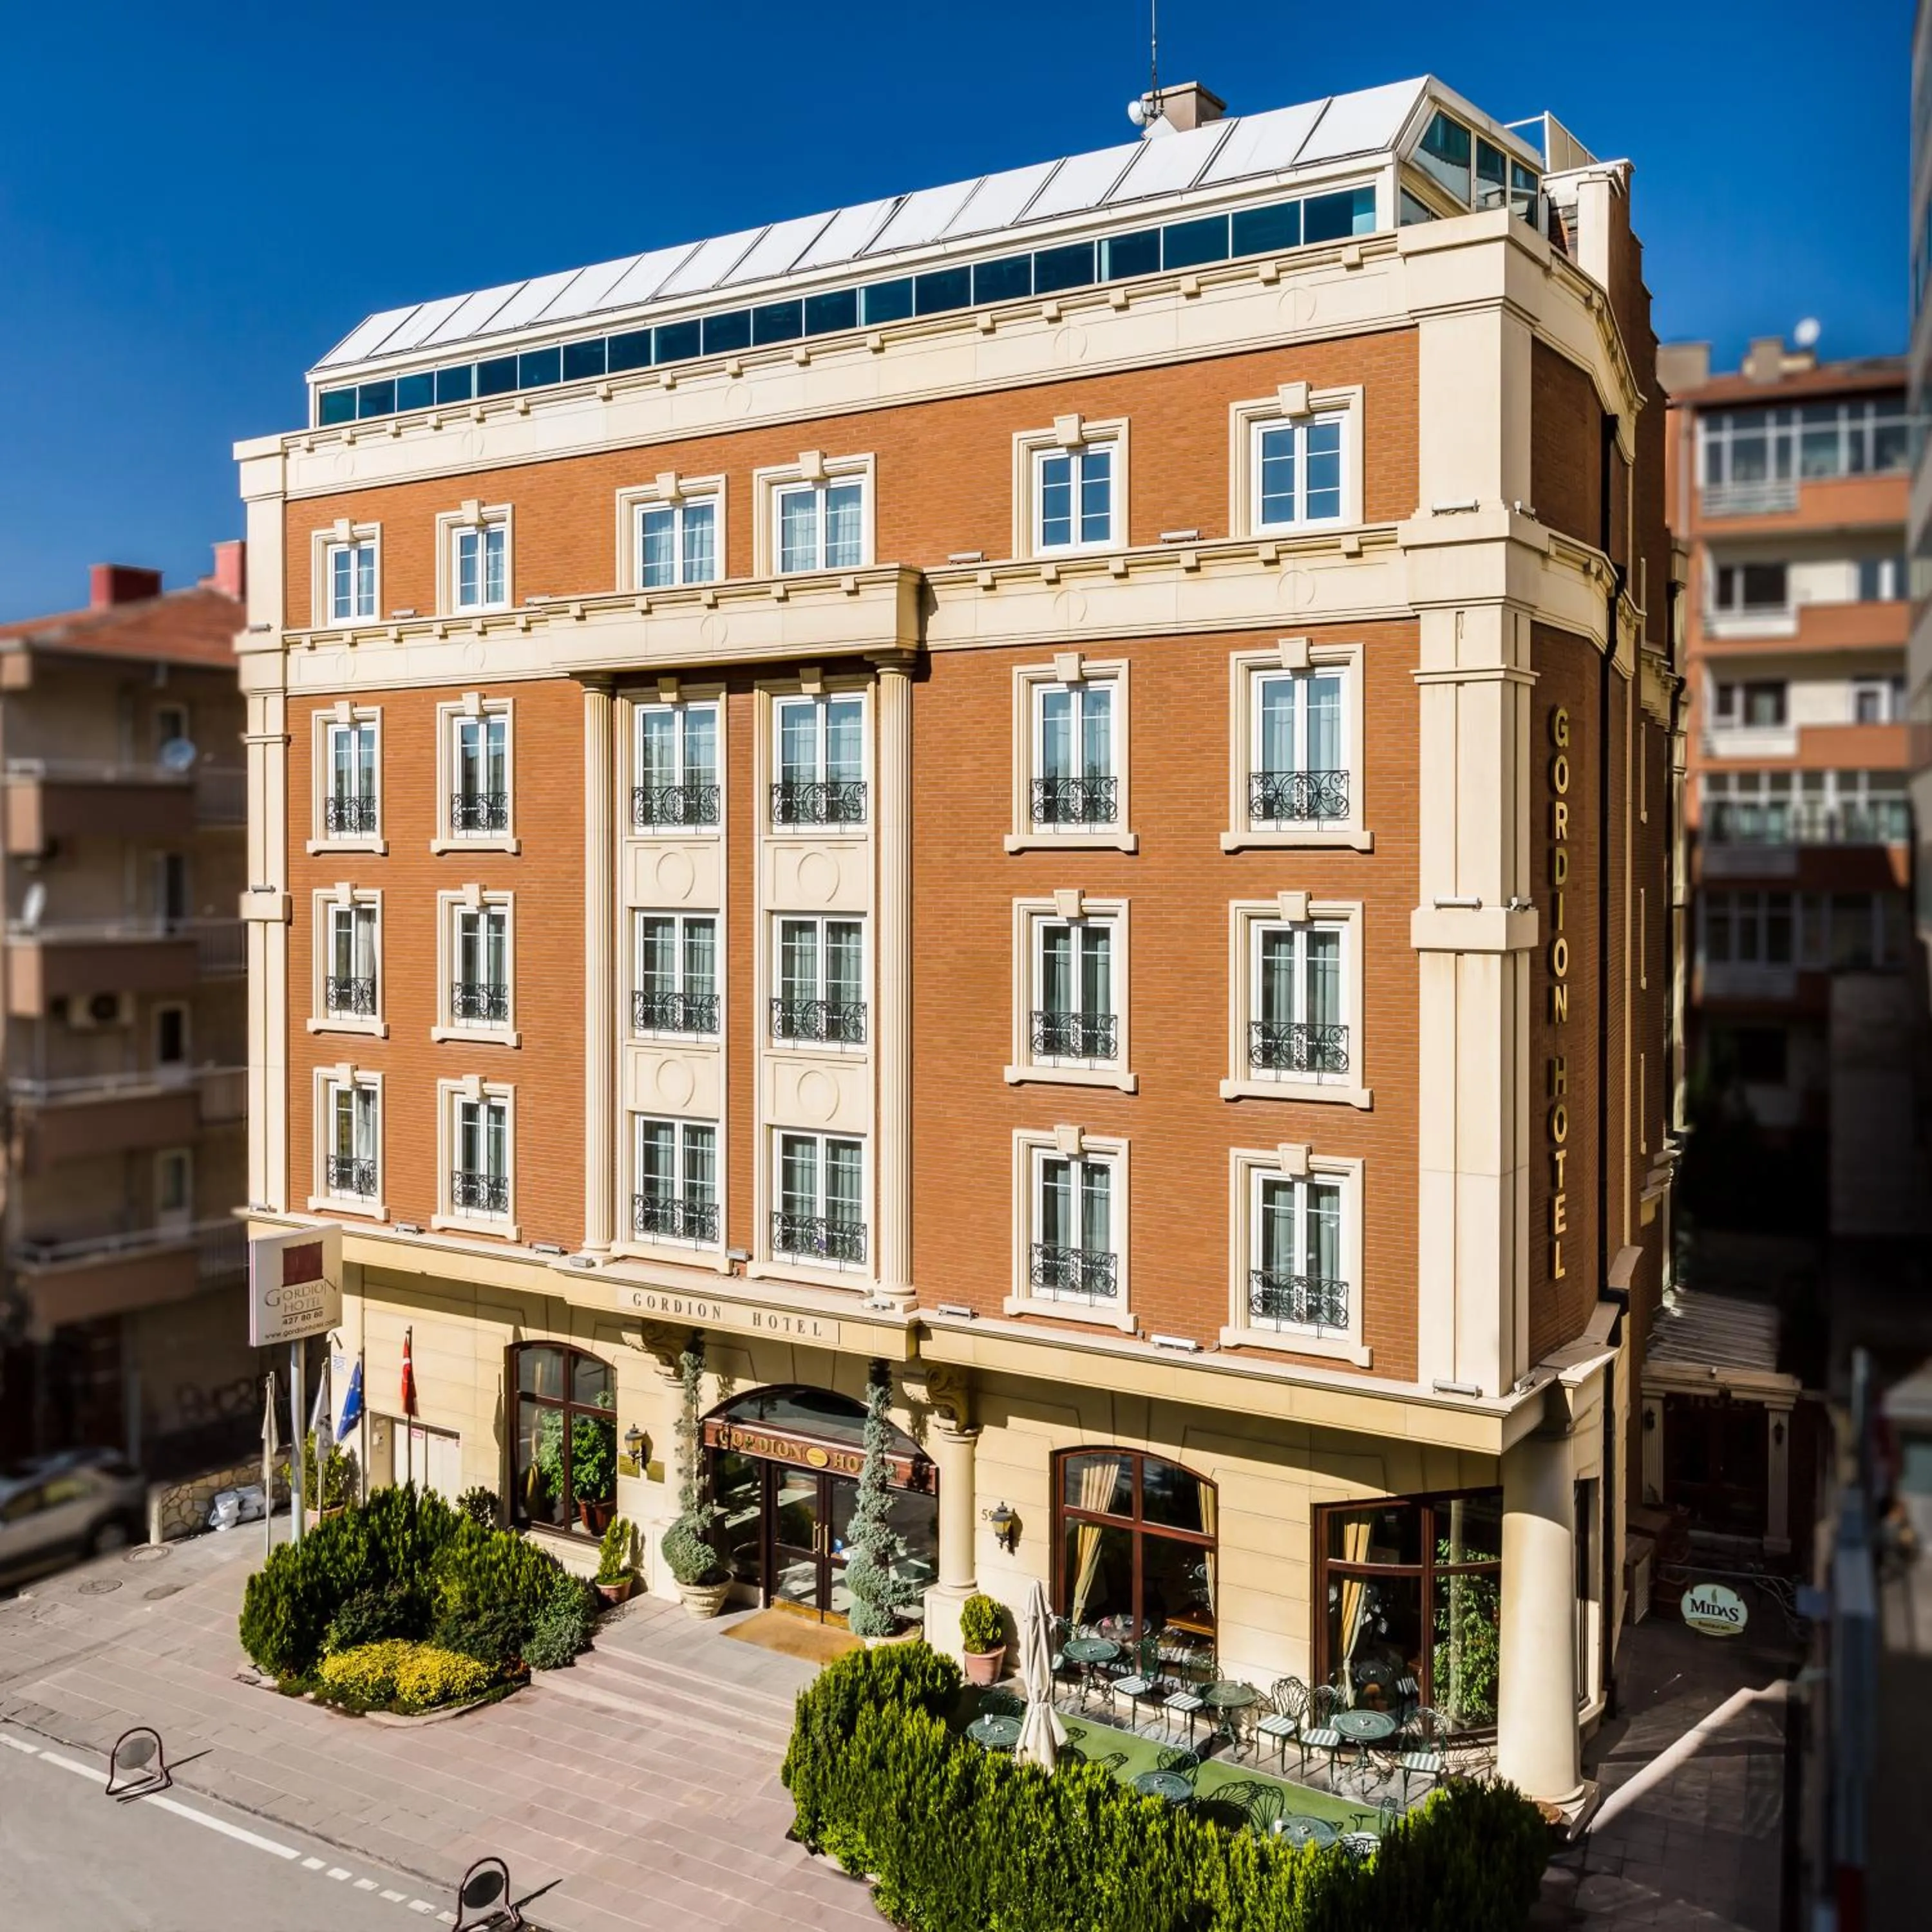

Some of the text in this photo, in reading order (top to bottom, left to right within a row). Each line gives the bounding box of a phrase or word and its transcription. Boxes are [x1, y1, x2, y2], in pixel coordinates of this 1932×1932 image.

[1551, 707, 1570, 1280] GORDION HOTEL
[265, 1277, 337, 1307] GORDION
[284, 1296, 321, 1313] HOTEL
[283, 1316, 298, 1325] 427
[633, 1292, 822, 1337] GORDION HOTEL
[1690, 1598, 1739, 1622] MIDAS
